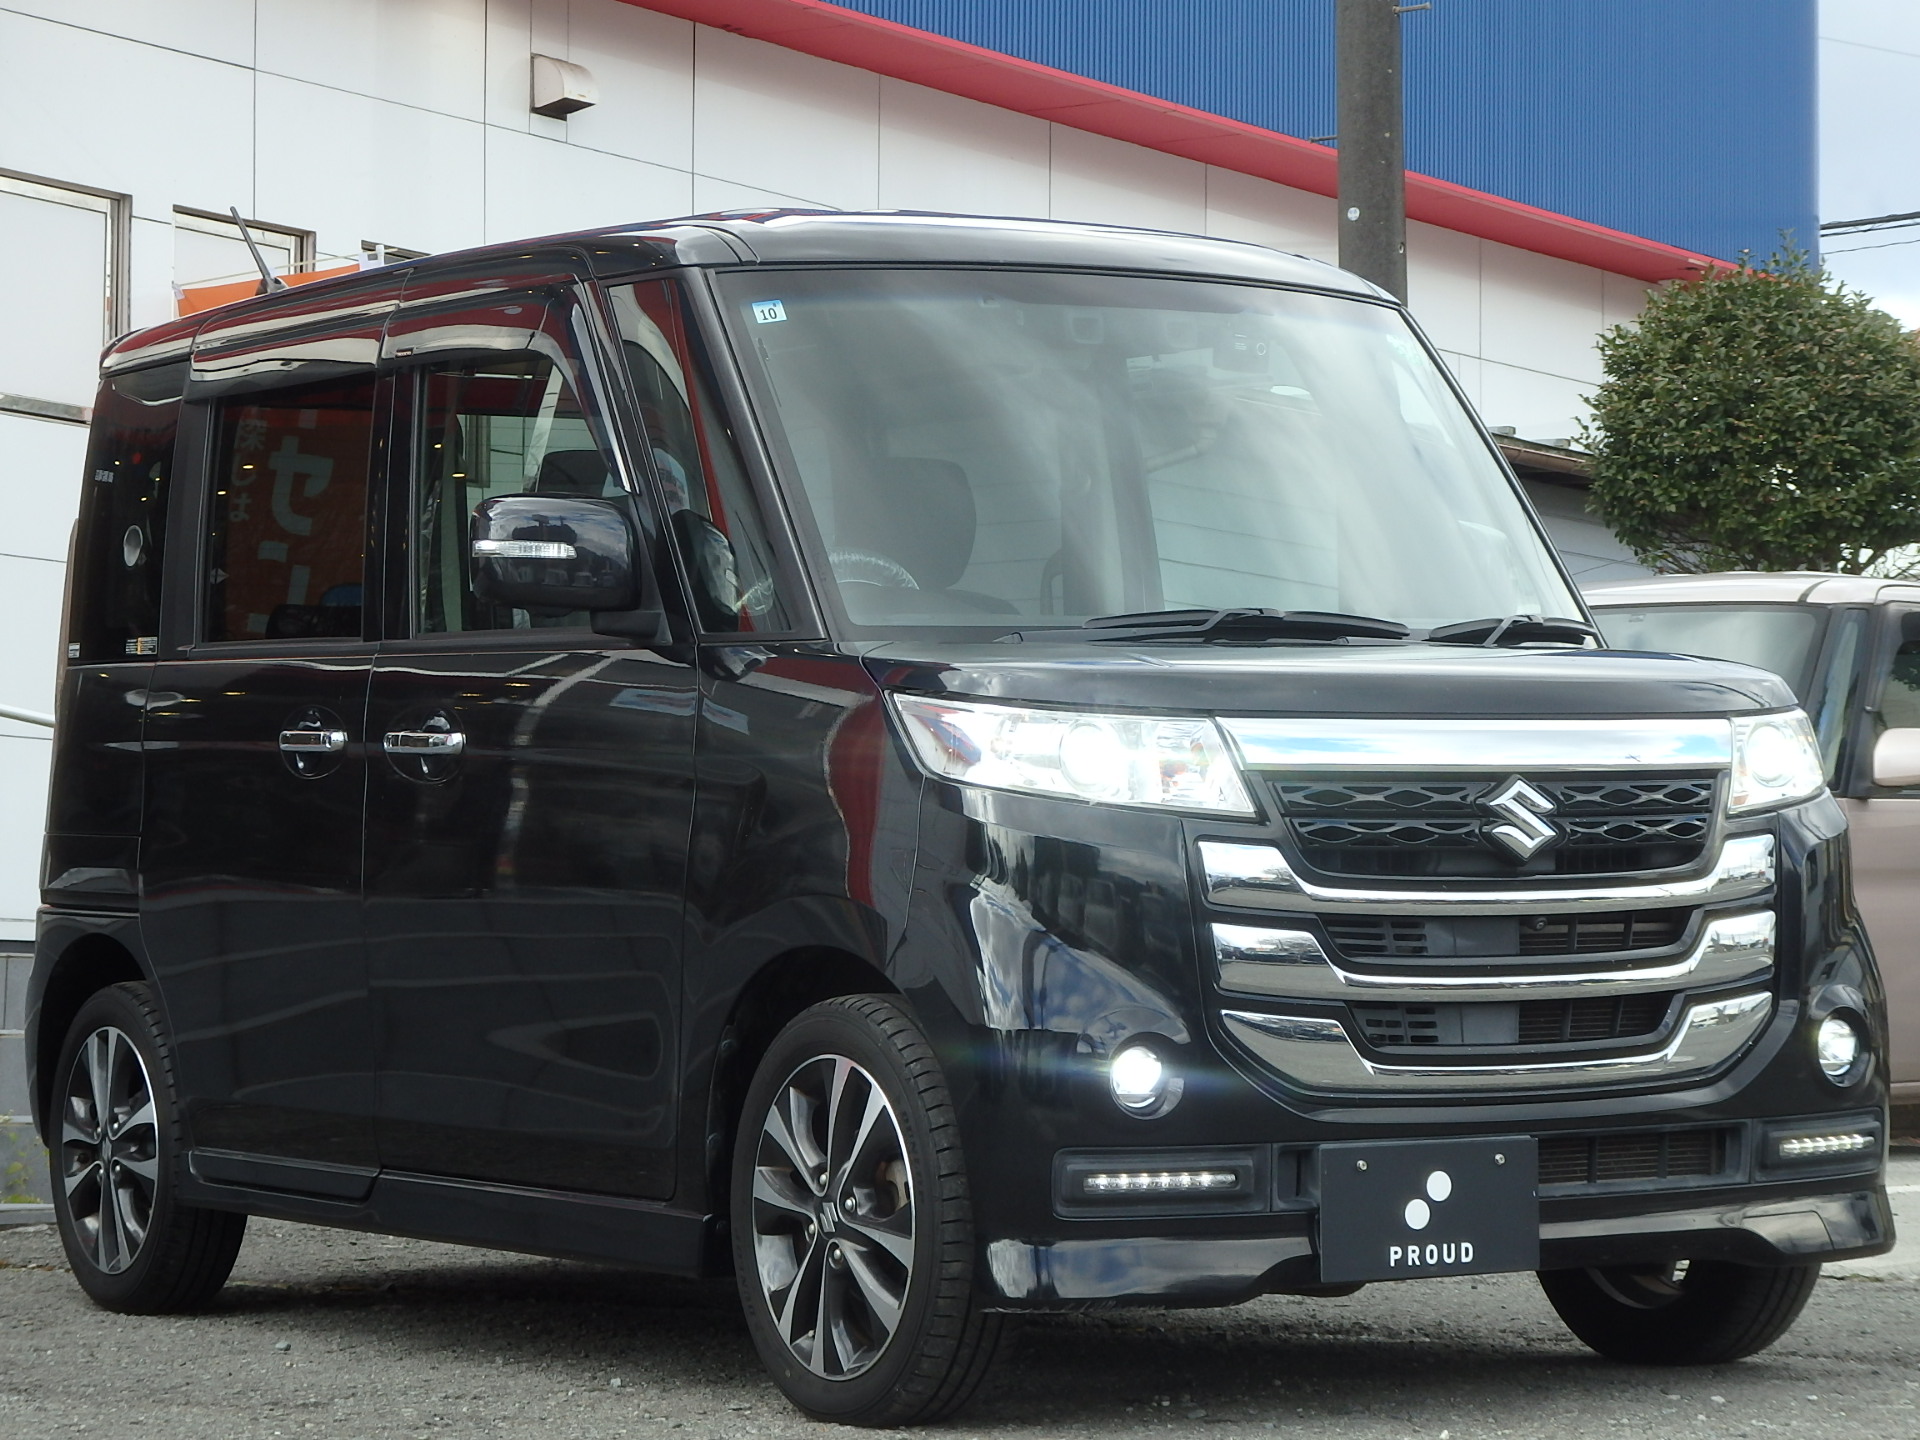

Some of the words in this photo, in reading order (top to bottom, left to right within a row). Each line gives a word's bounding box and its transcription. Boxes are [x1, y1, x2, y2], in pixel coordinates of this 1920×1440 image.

[760, 307, 777, 321] 10
[229, 408, 267, 523] 探しは
[1389, 1242, 1474, 1267] PROUD
